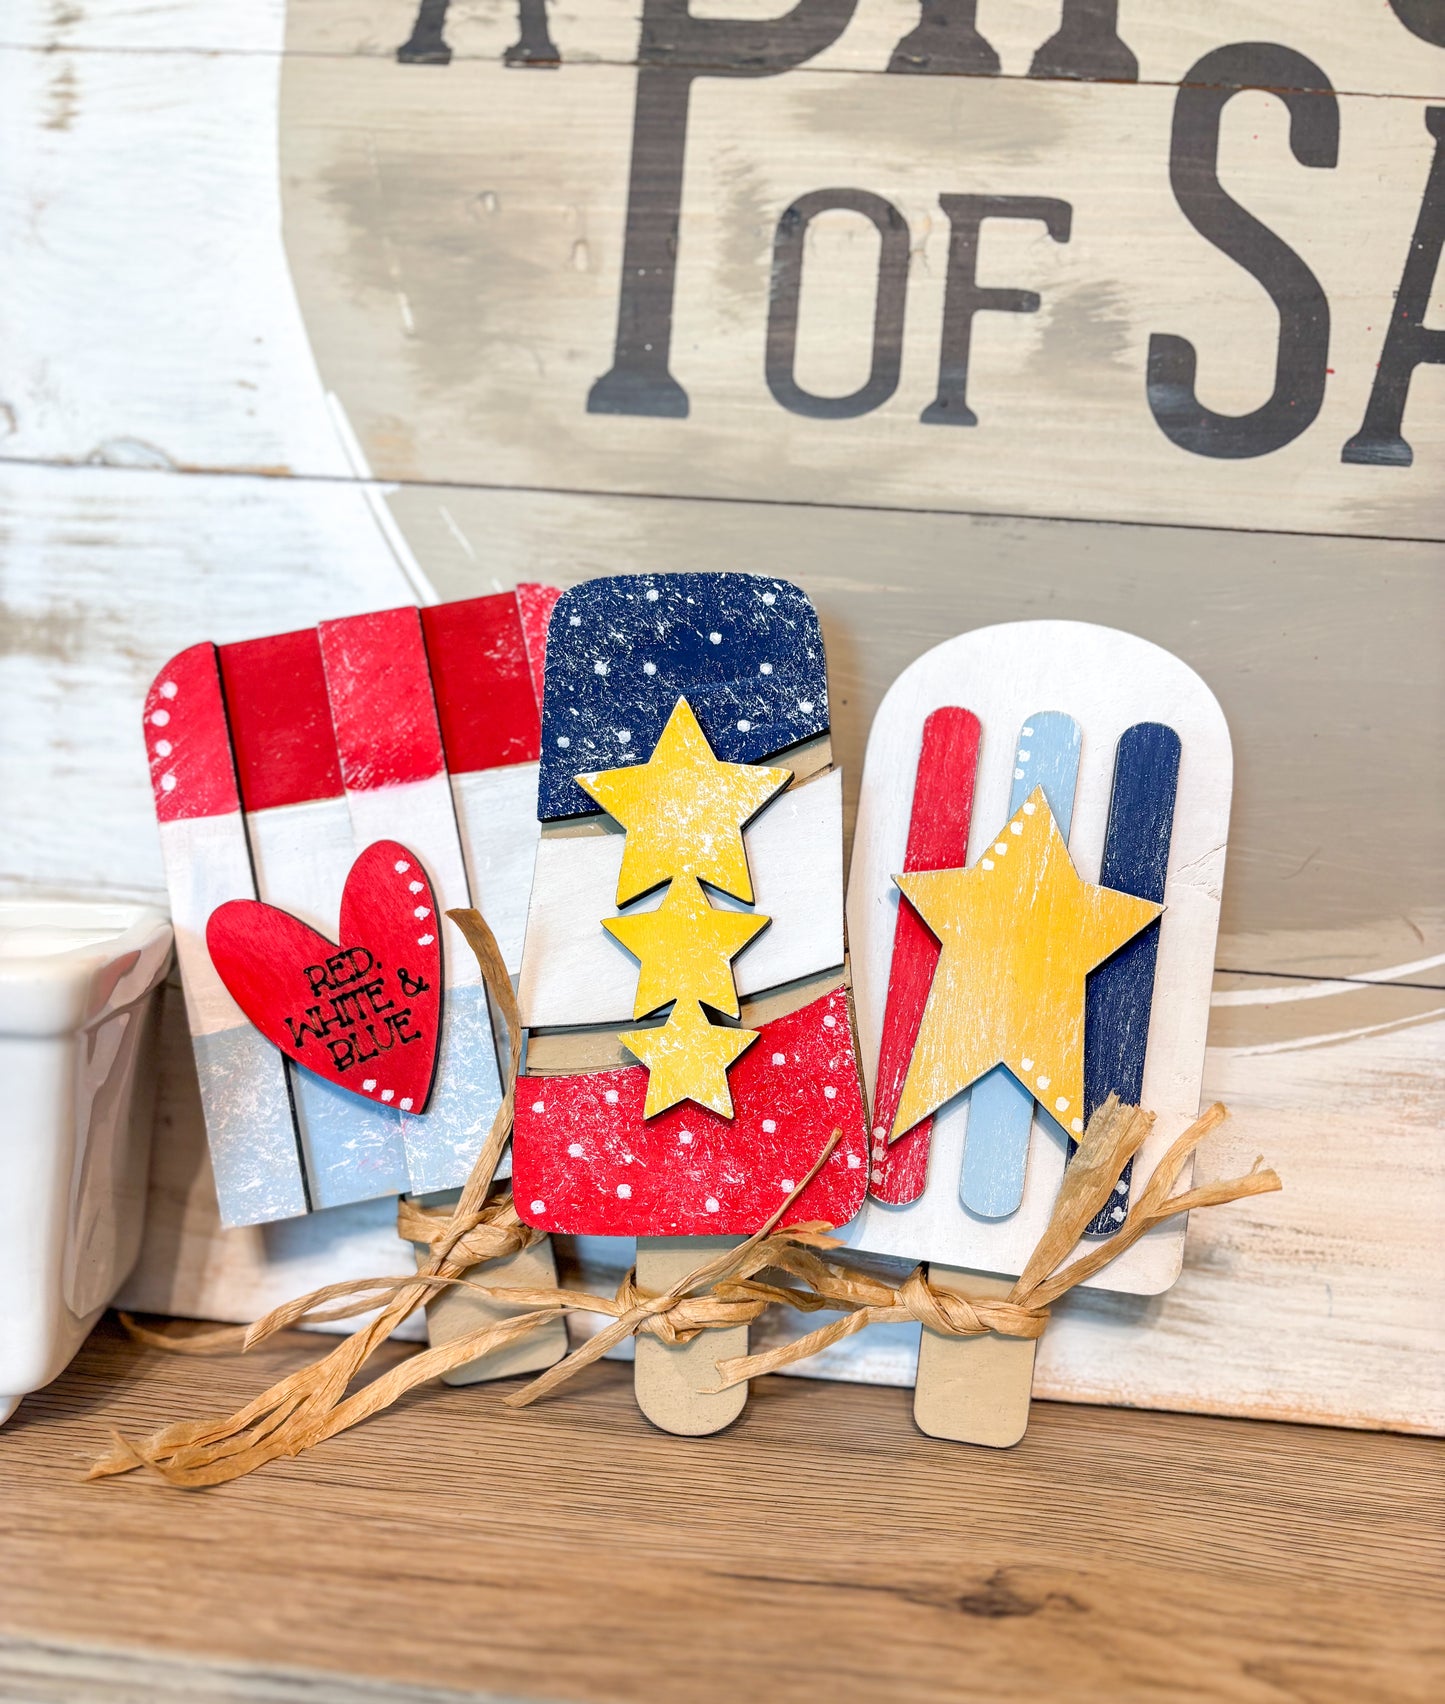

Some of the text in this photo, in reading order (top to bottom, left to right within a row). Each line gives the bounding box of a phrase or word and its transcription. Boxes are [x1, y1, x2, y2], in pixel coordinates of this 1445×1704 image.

[765, 187, 1072, 427] OF
[284, 967, 430, 1047] WHITE &
[326, 1007, 422, 1072] BLUE
